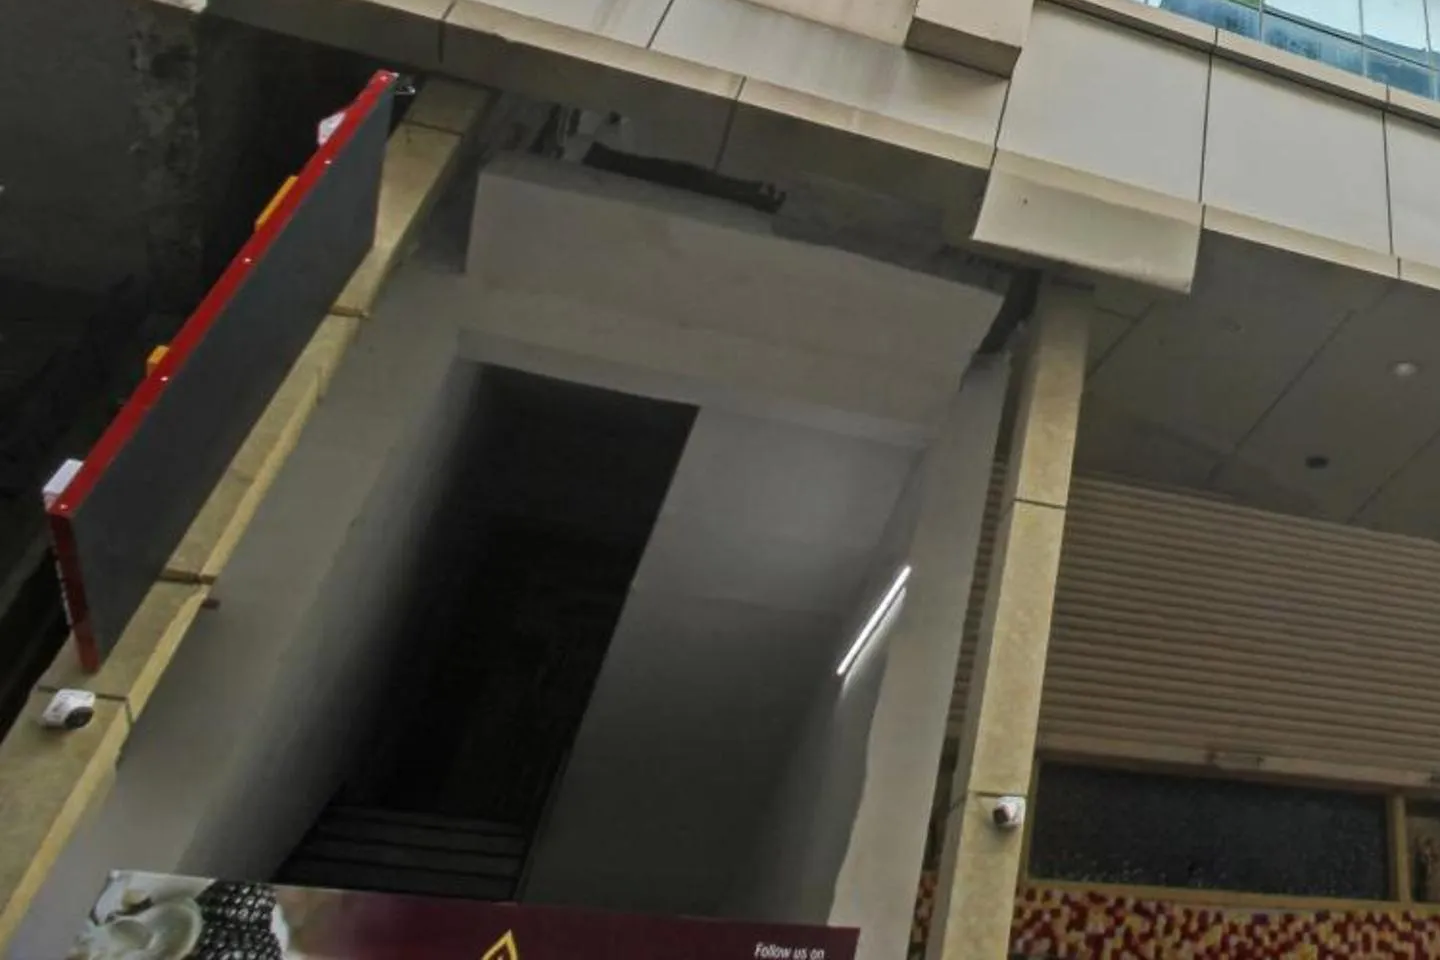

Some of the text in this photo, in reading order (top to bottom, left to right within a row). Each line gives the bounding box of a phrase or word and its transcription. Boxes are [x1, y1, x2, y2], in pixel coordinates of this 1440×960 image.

[754, 942, 825, 960] Follow us on
